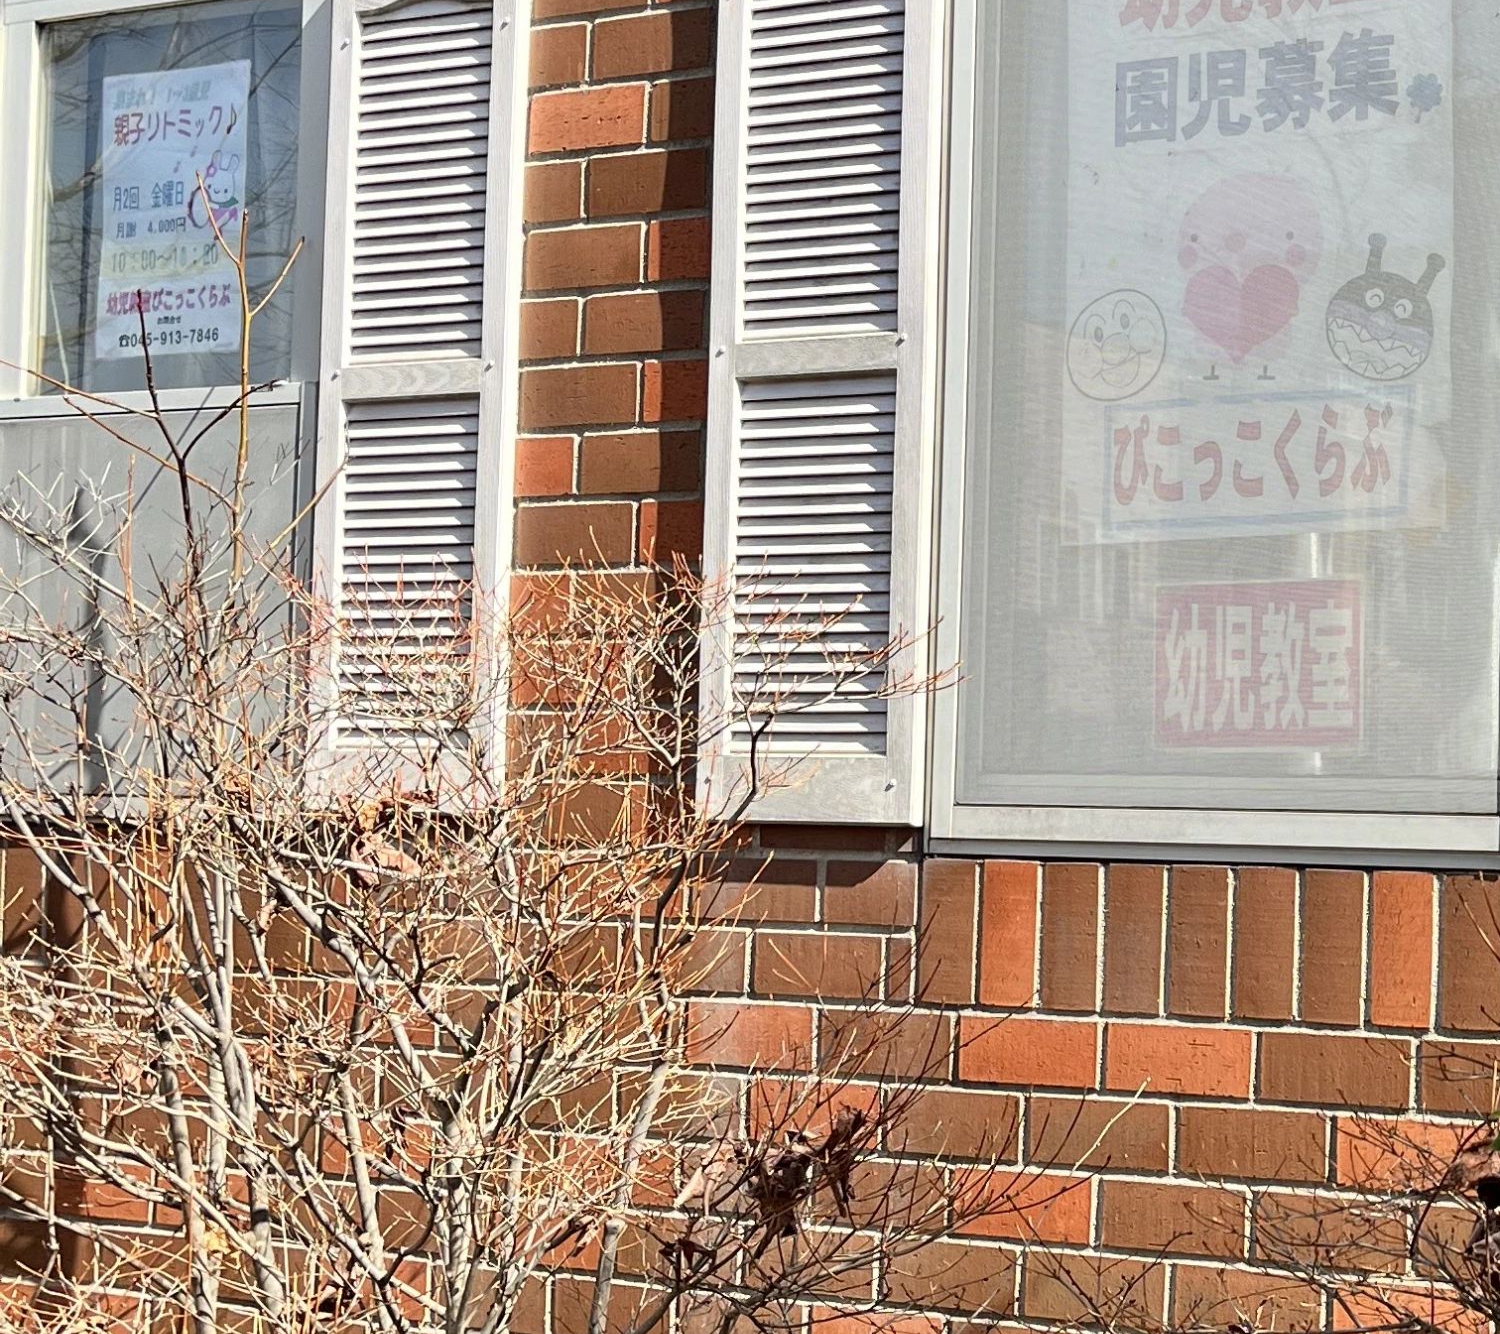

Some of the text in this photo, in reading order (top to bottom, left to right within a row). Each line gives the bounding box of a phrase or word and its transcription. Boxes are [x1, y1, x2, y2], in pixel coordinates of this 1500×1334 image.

[1113, 27, 1401, 148] 園児募集
[112, 180, 185, 212] 月2回 金曜日
[1113, 401, 1394, 506] ぴこっこくらぶ
[1163, 599, 1353, 732] 幼児教室
